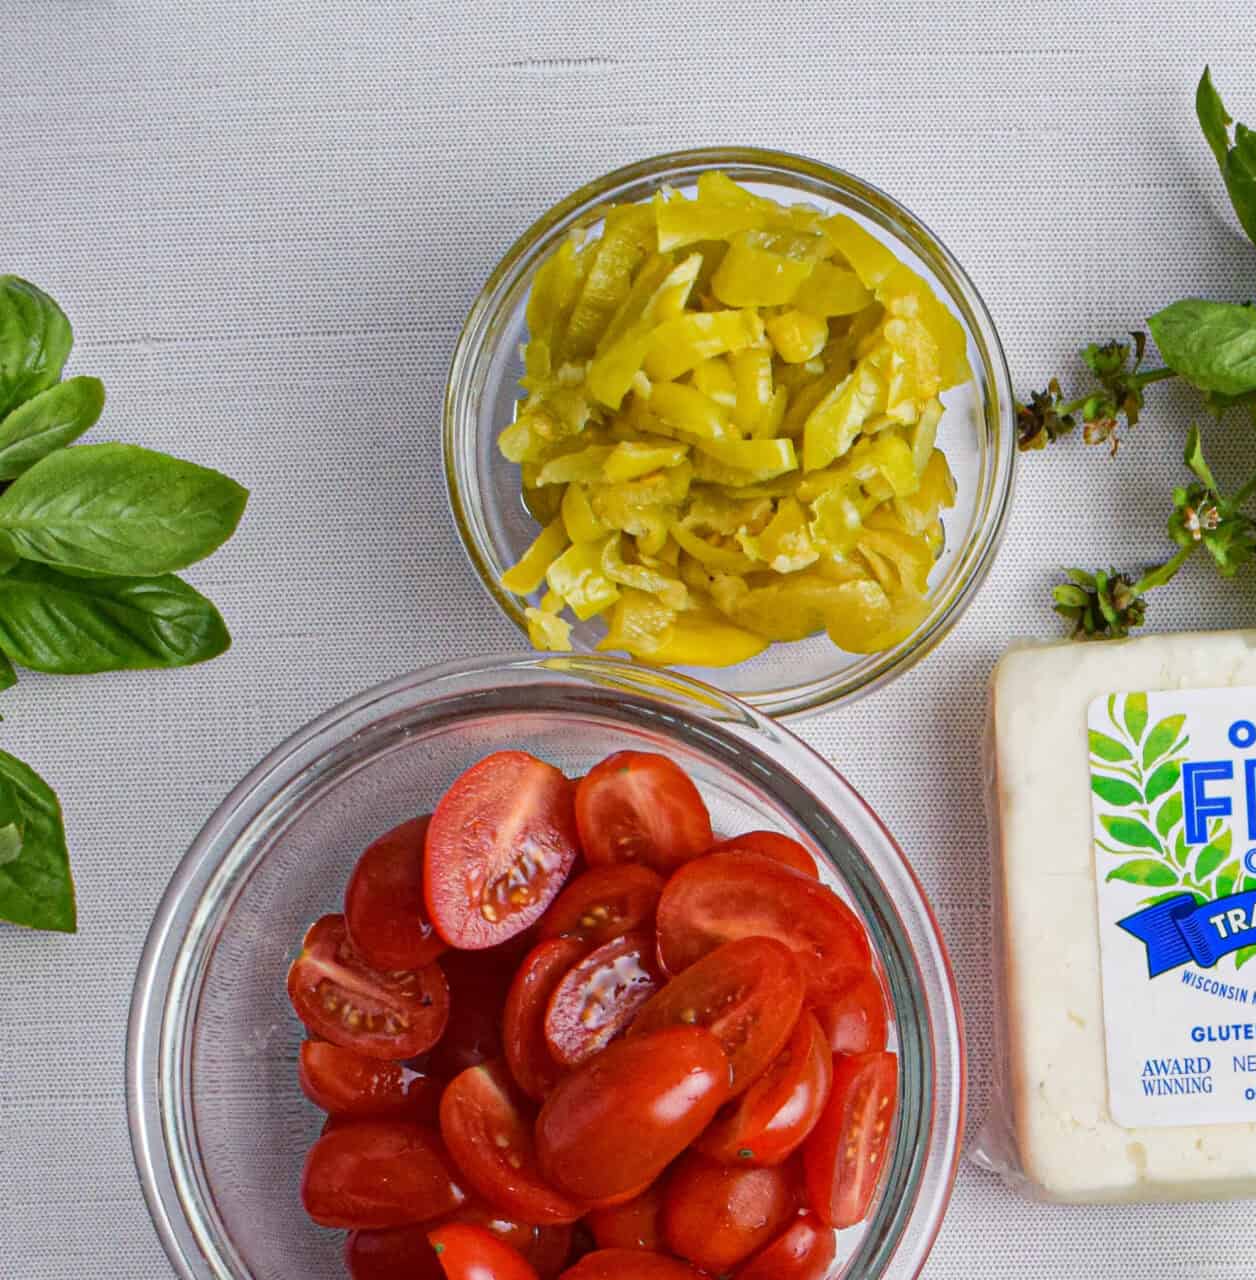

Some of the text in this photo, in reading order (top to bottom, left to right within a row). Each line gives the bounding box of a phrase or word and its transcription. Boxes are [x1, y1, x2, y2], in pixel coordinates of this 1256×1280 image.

[1181, 969, 1249, 1003] WISCONSIN
[1141, 1056, 1212, 1078] AWARD
[1142, 1076, 1213, 1097] WINNING
